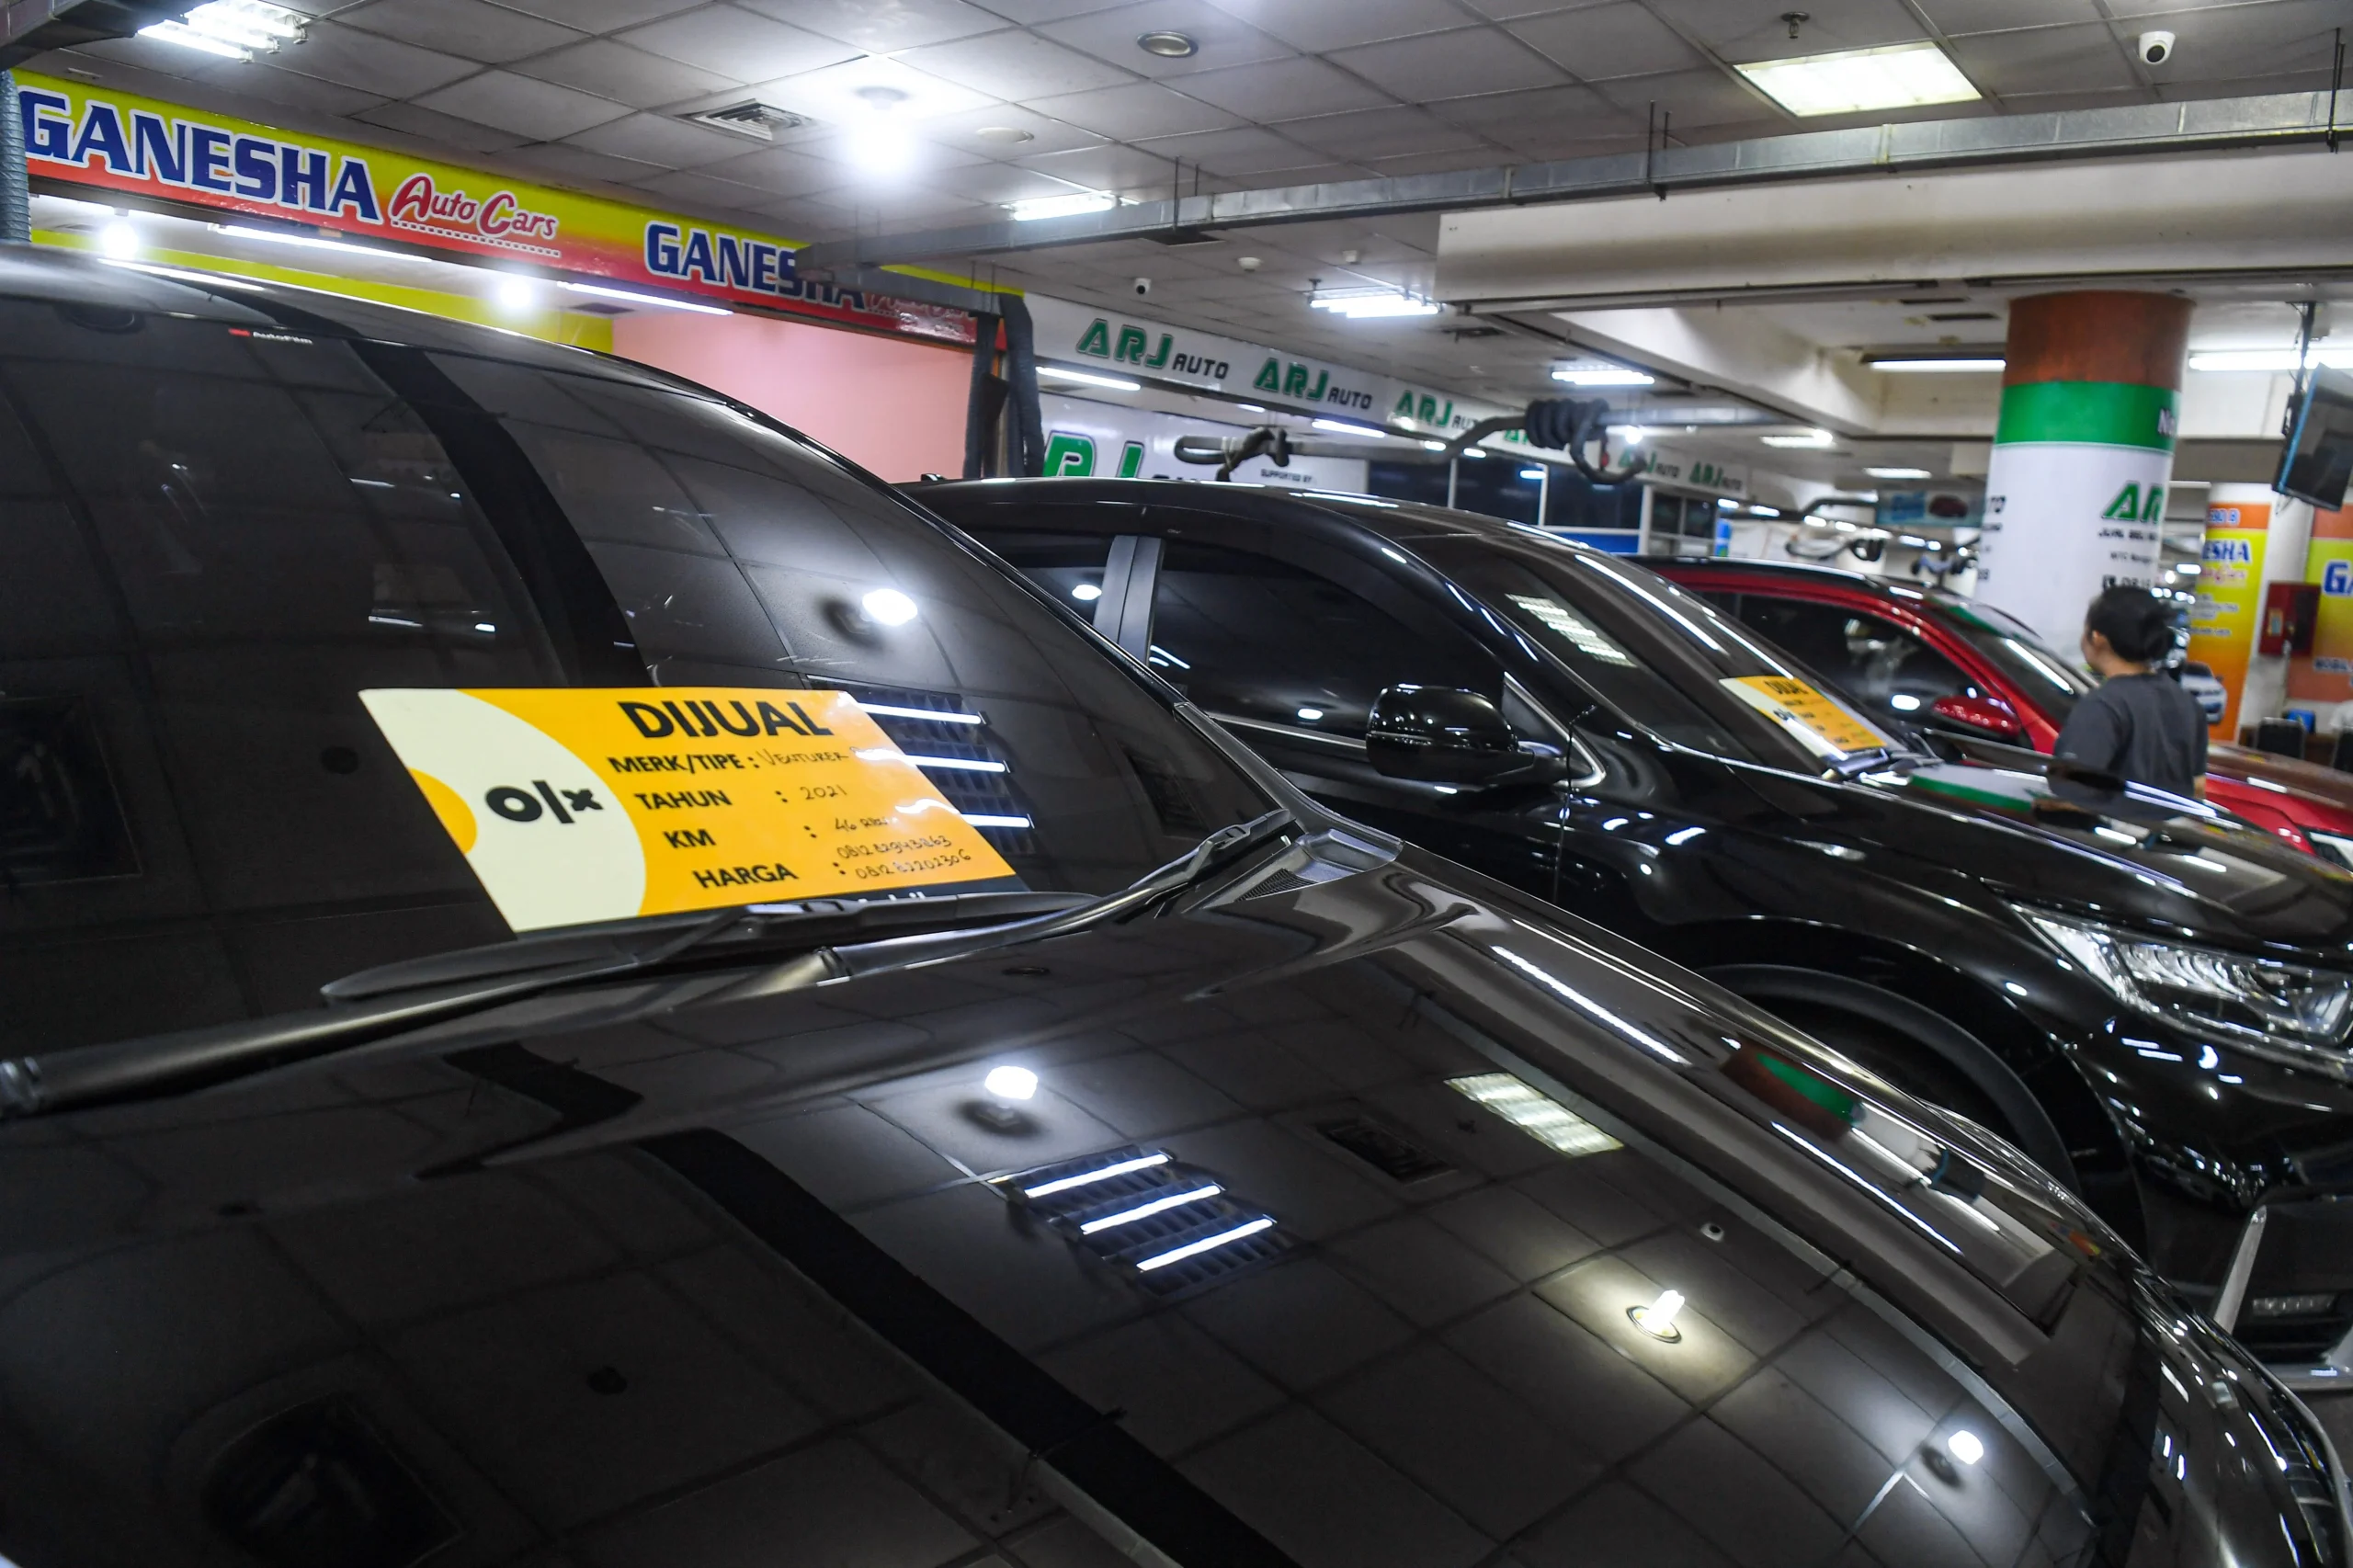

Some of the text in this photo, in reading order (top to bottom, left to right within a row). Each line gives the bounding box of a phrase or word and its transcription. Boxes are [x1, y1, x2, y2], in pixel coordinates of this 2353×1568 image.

[20, 87, 559, 238] GANESHA Auto Cars
[1076, 319, 1229, 379] ARJ AUTO
[1254, 358, 1372, 410] ARJ AUTO
[1395, 390, 1453, 427] ARJ
[617, 700, 835, 738] DIJUAL
[607, 754, 745, 774] MERK/TIPE
[485, 780, 604, 824] olx
[633, 790, 733, 811] TAHUN
[800, 784, 847, 801] 2021
[663, 829, 716, 850] KM
[692, 863, 799, 889] HARGA
